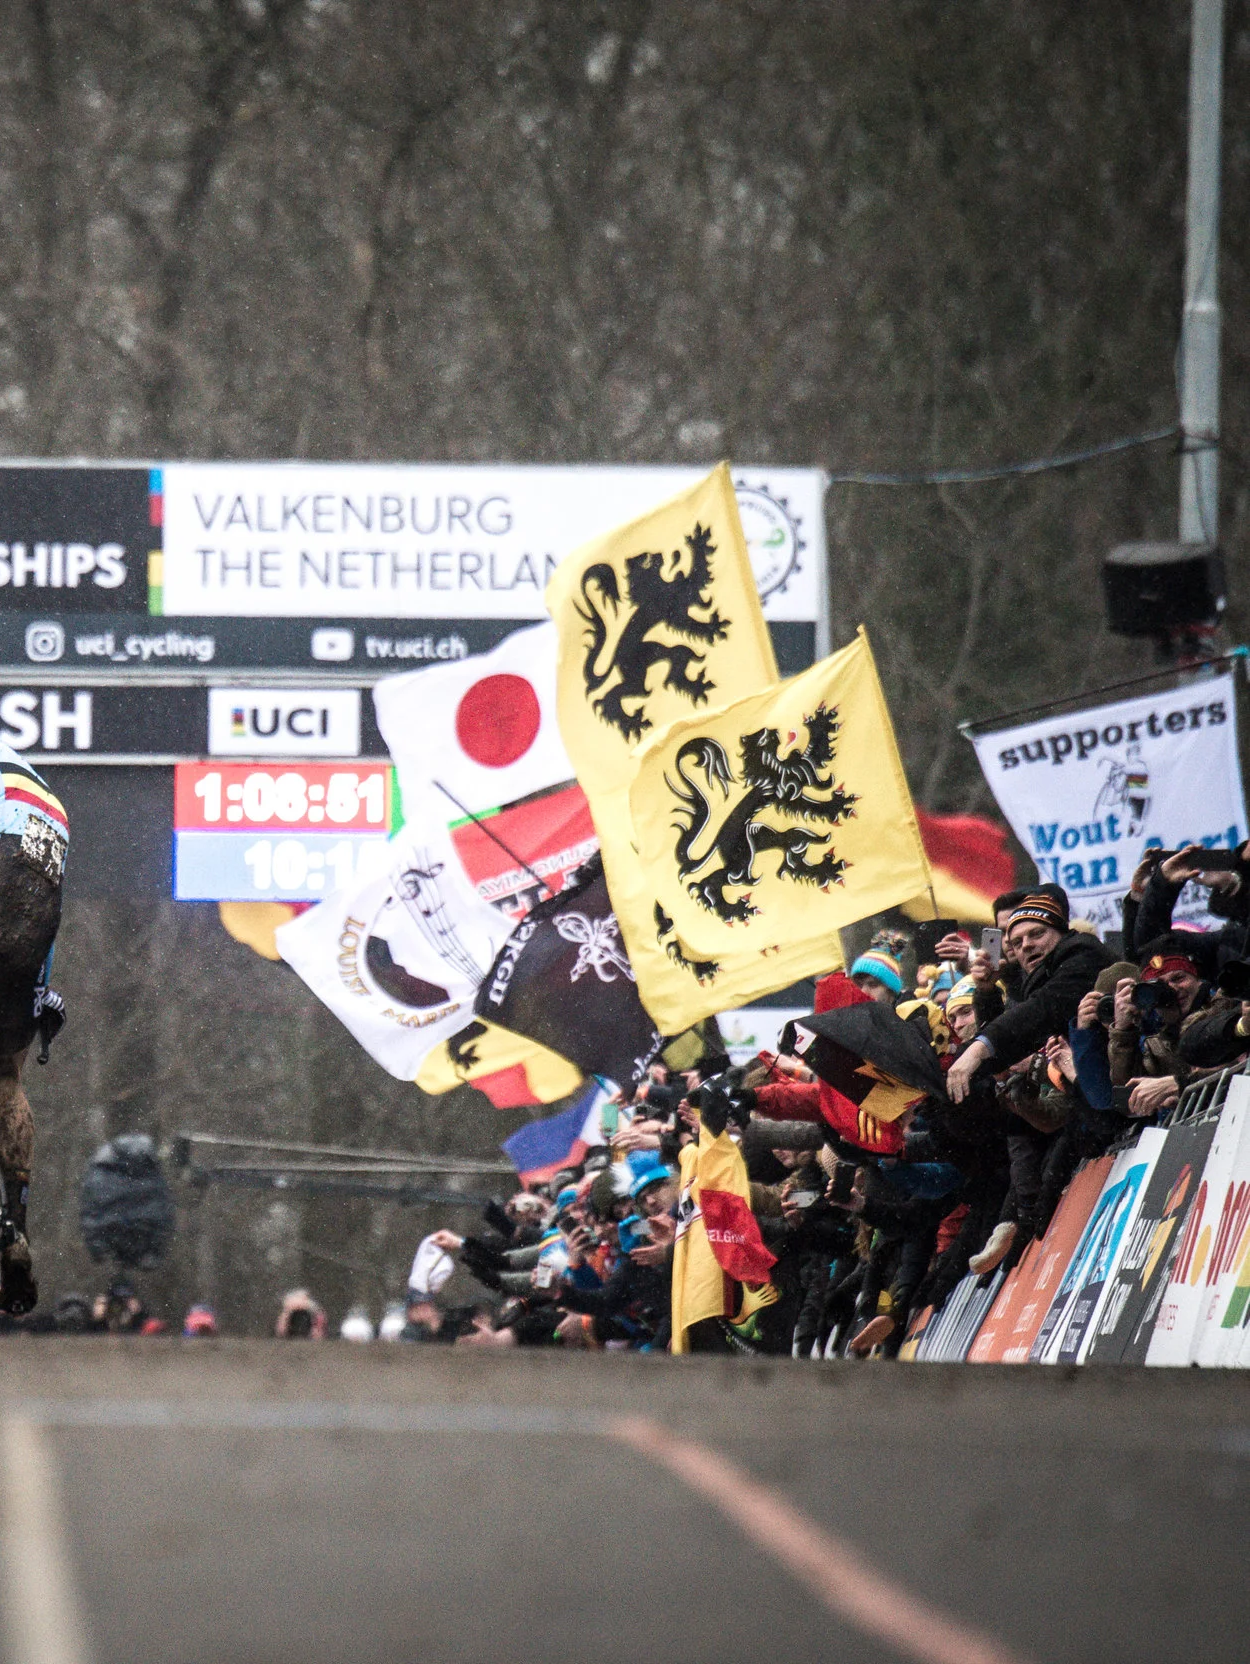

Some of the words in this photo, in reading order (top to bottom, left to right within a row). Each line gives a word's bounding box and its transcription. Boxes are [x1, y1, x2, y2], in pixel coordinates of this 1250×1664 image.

[193, 494, 513, 536] VALKENBURG
[196, 549, 280, 589] THE
[301, 551, 557, 591] NETHERLA
[75, 633, 216, 662] uci_cycling
[365, 637, 468, 659] tv.uci.ch
[250, 707, 329, 738] UCI
[998, 700, 1228, 771] supporters
[1029, 813, 1122, 854] Wout
